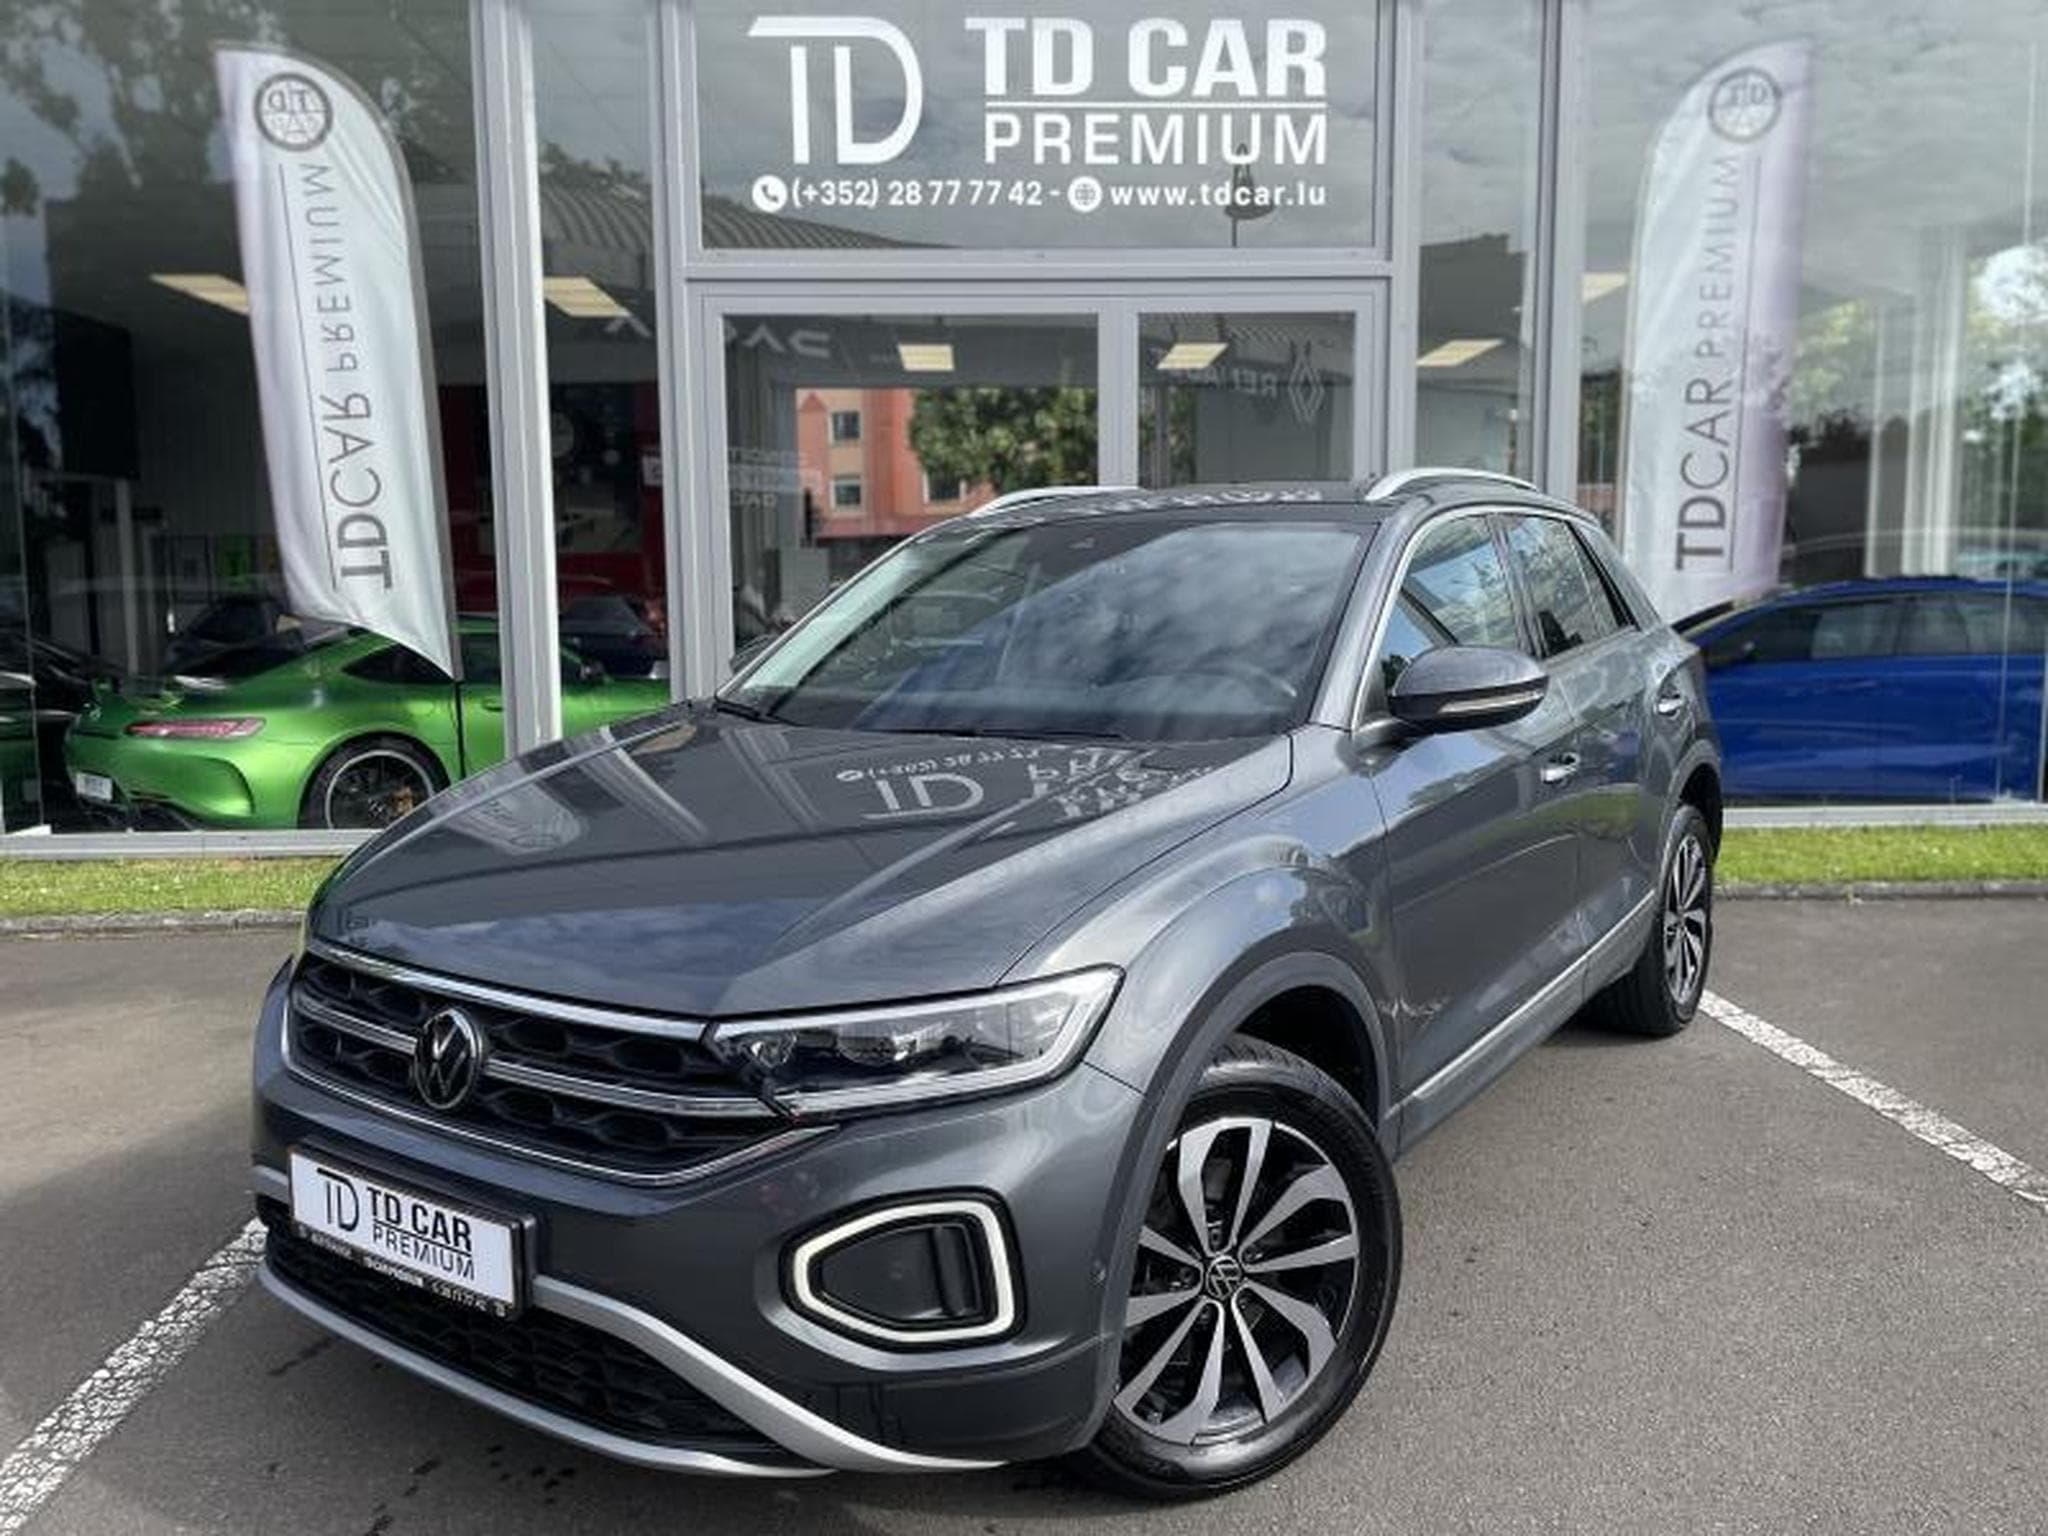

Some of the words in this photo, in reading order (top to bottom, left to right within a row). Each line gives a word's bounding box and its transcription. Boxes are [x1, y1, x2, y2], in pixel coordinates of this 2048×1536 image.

[964, 18, 1094, 97] TD
[1127, 18, 1327, 97] CAR
[984, 113, 1327, 165] PREMIUM
[791, 177, 879, 208] (+352)
[887, 180, 922, 206] 28
[927, 179, 962, 206] 77
[967, 179, 1002, 206] 77
[1007, 179, 1043, 206] 42
[1110, 181, 1326, 207] www.tdcar.lu
[1696, 156, 1742, 359] PREMIUM
[1675, 377, 1732, 571] TDCAR
[366, 1186, 403, 1226] TD
[411, 1203, 473, 1252] CAR
[372, 1222, 476, 1281] PREMIUM
